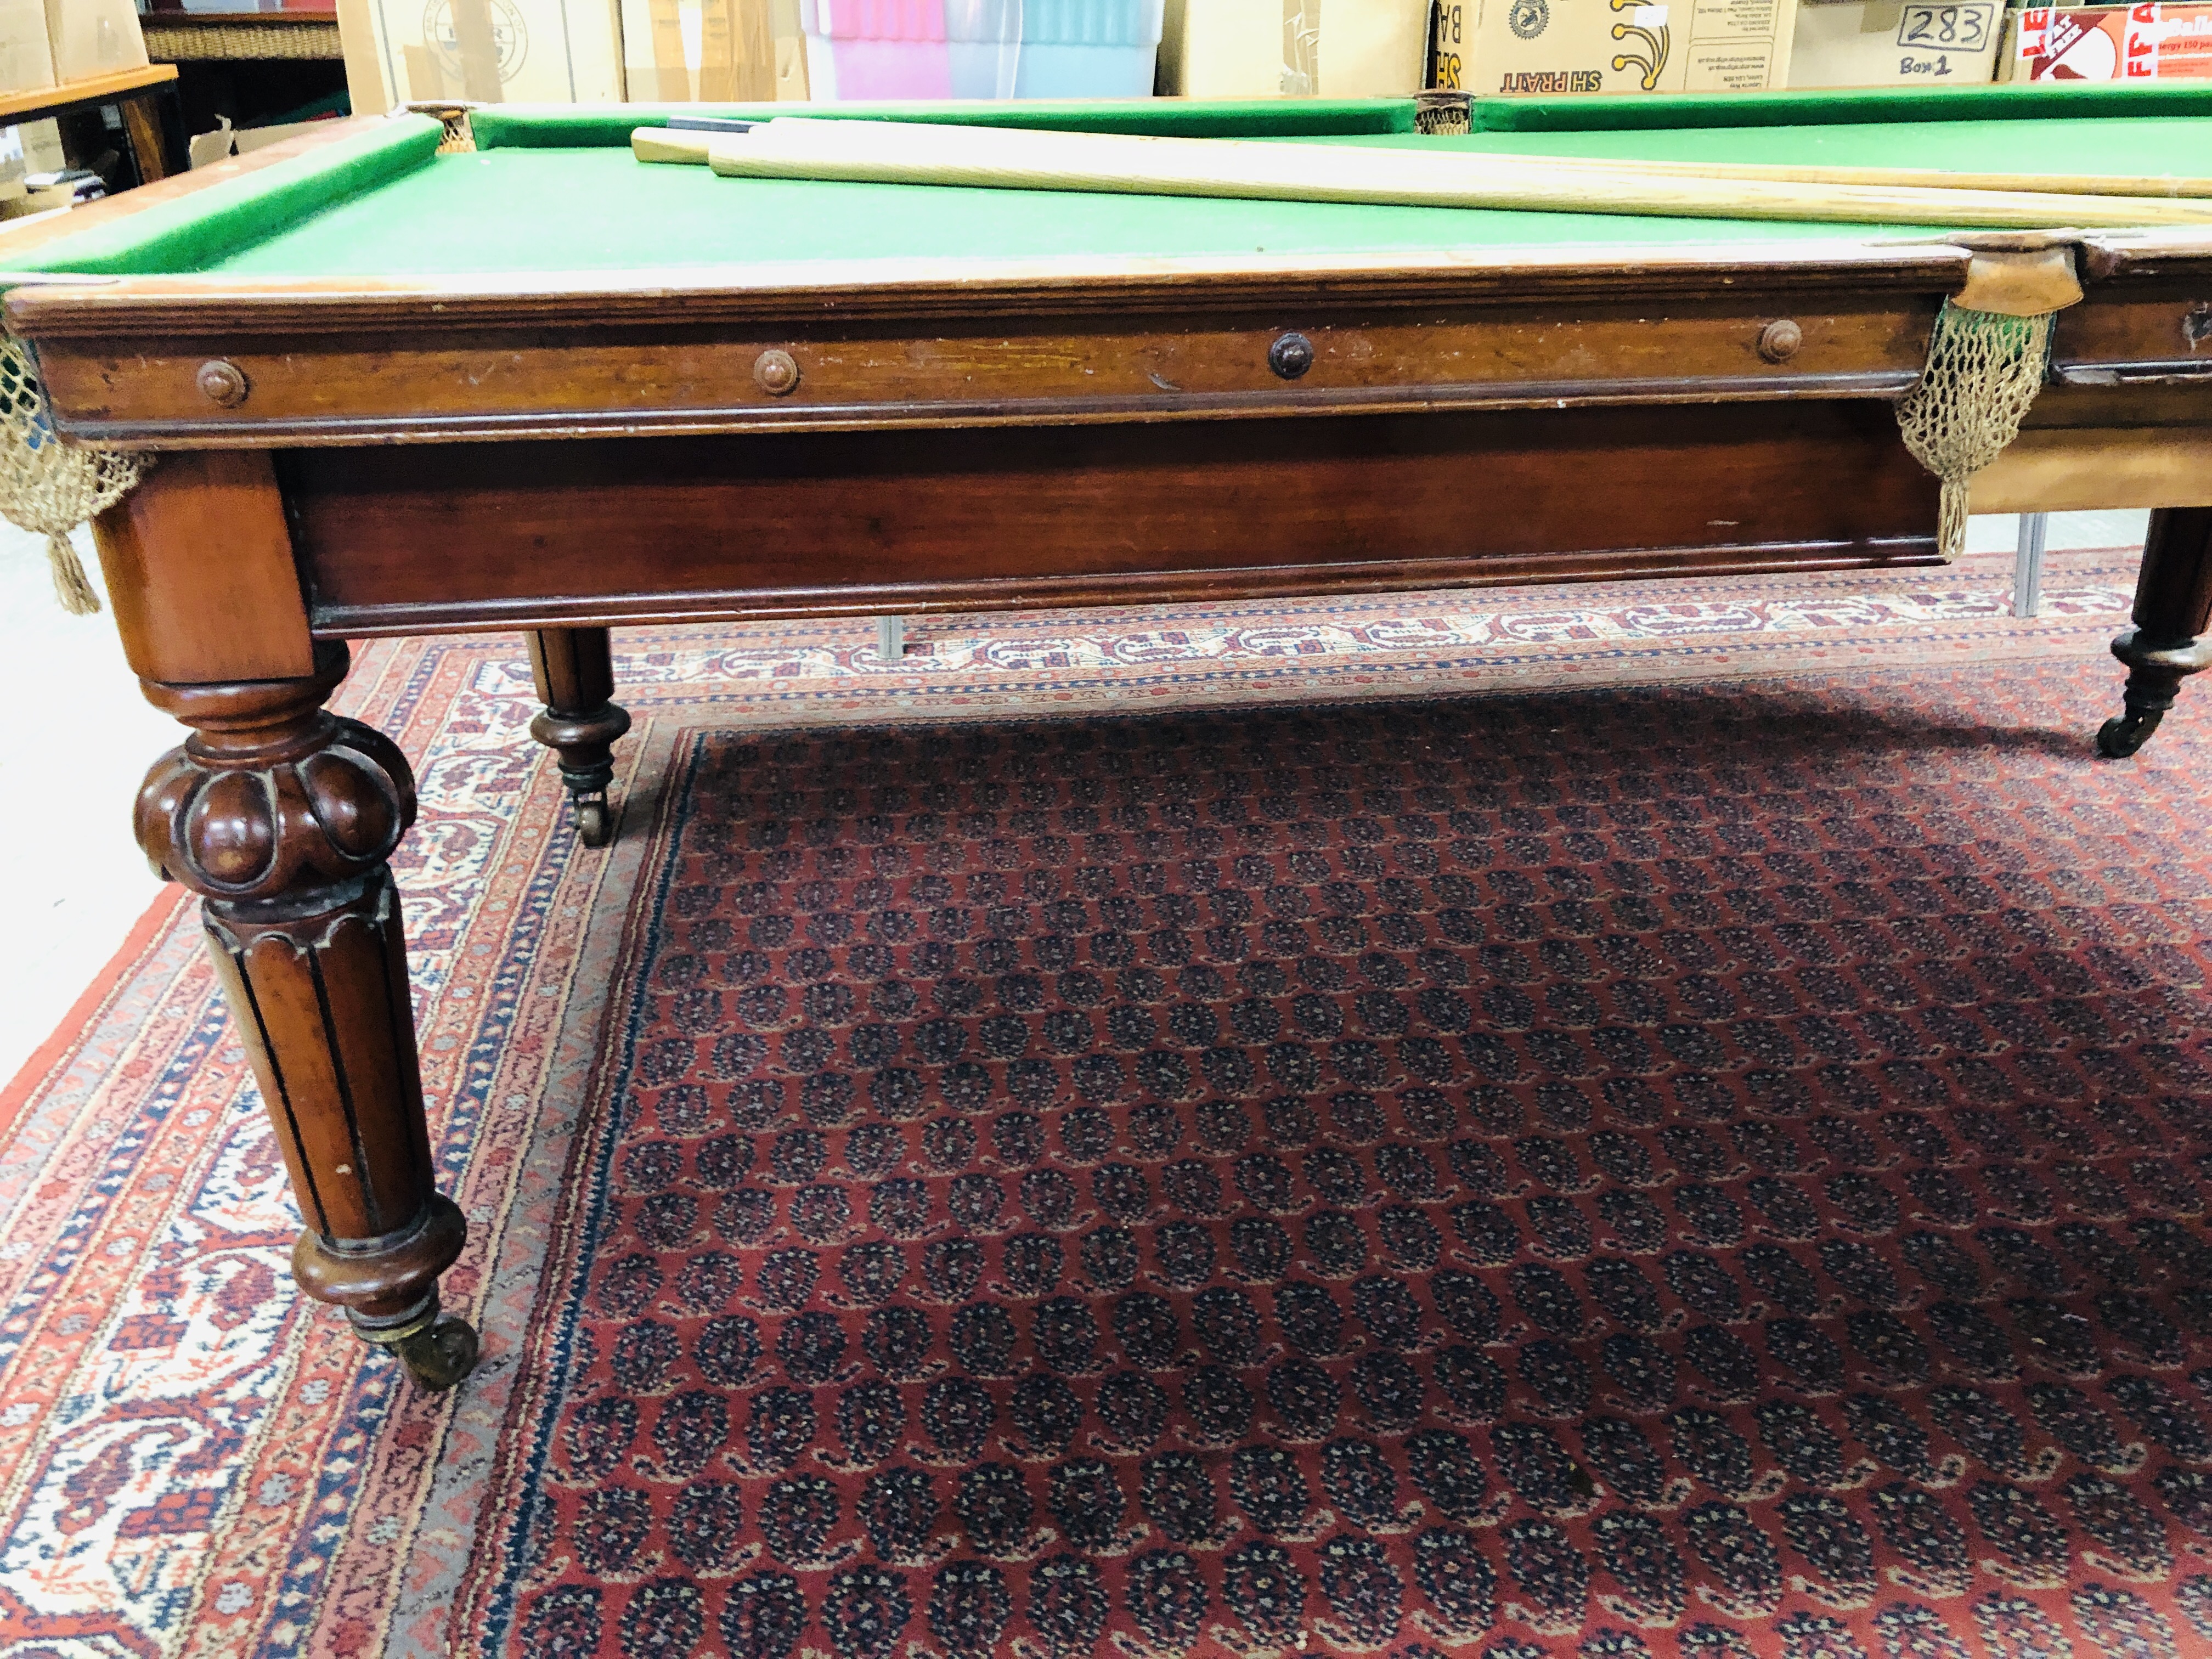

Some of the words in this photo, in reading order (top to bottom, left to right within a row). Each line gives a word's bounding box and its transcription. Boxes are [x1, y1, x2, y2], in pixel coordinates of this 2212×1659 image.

[1908, 7, 1982, 43] 283
[1900, 57, 1932, 75] Box
[1934, 54, 1953, 76] 1
[1500, 71, 1568, 93] PRATT
[1570, 70, 1603, 92] SH
